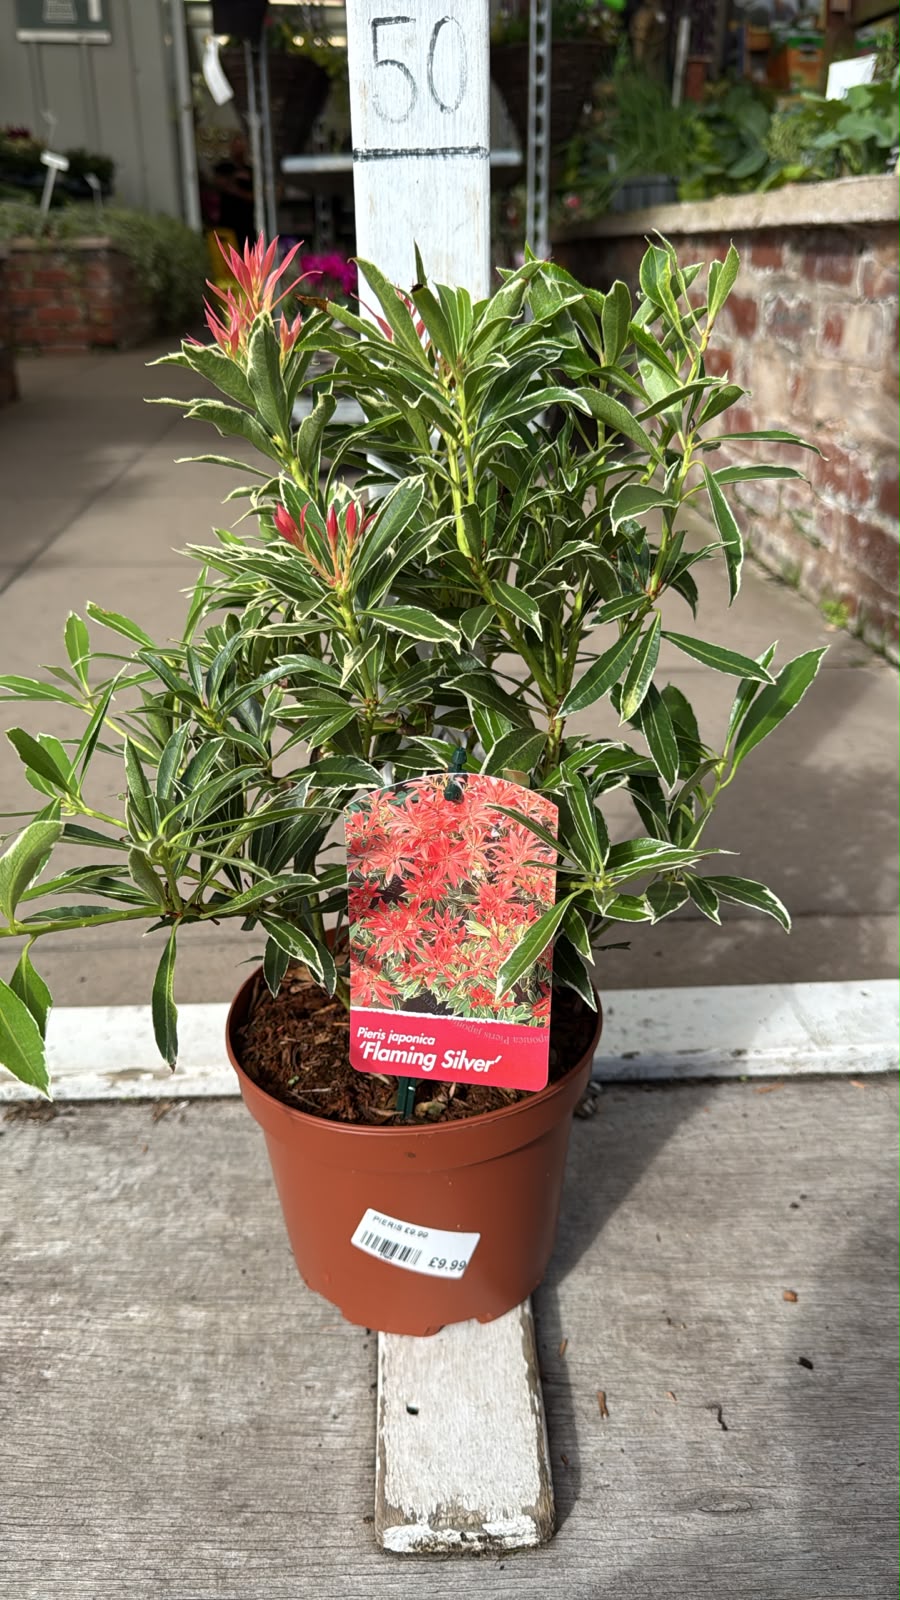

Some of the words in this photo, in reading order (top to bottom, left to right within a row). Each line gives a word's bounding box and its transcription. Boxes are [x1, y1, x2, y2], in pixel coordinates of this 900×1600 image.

[369, 16, 468, 124] 50
[357, 1026, 386, 1041] Pieris
[387, 1029, 436, 1046] japonica
[373, 1215, 402, 1232] PIERIS
[428, 1256, 467, 1272] £9.99
